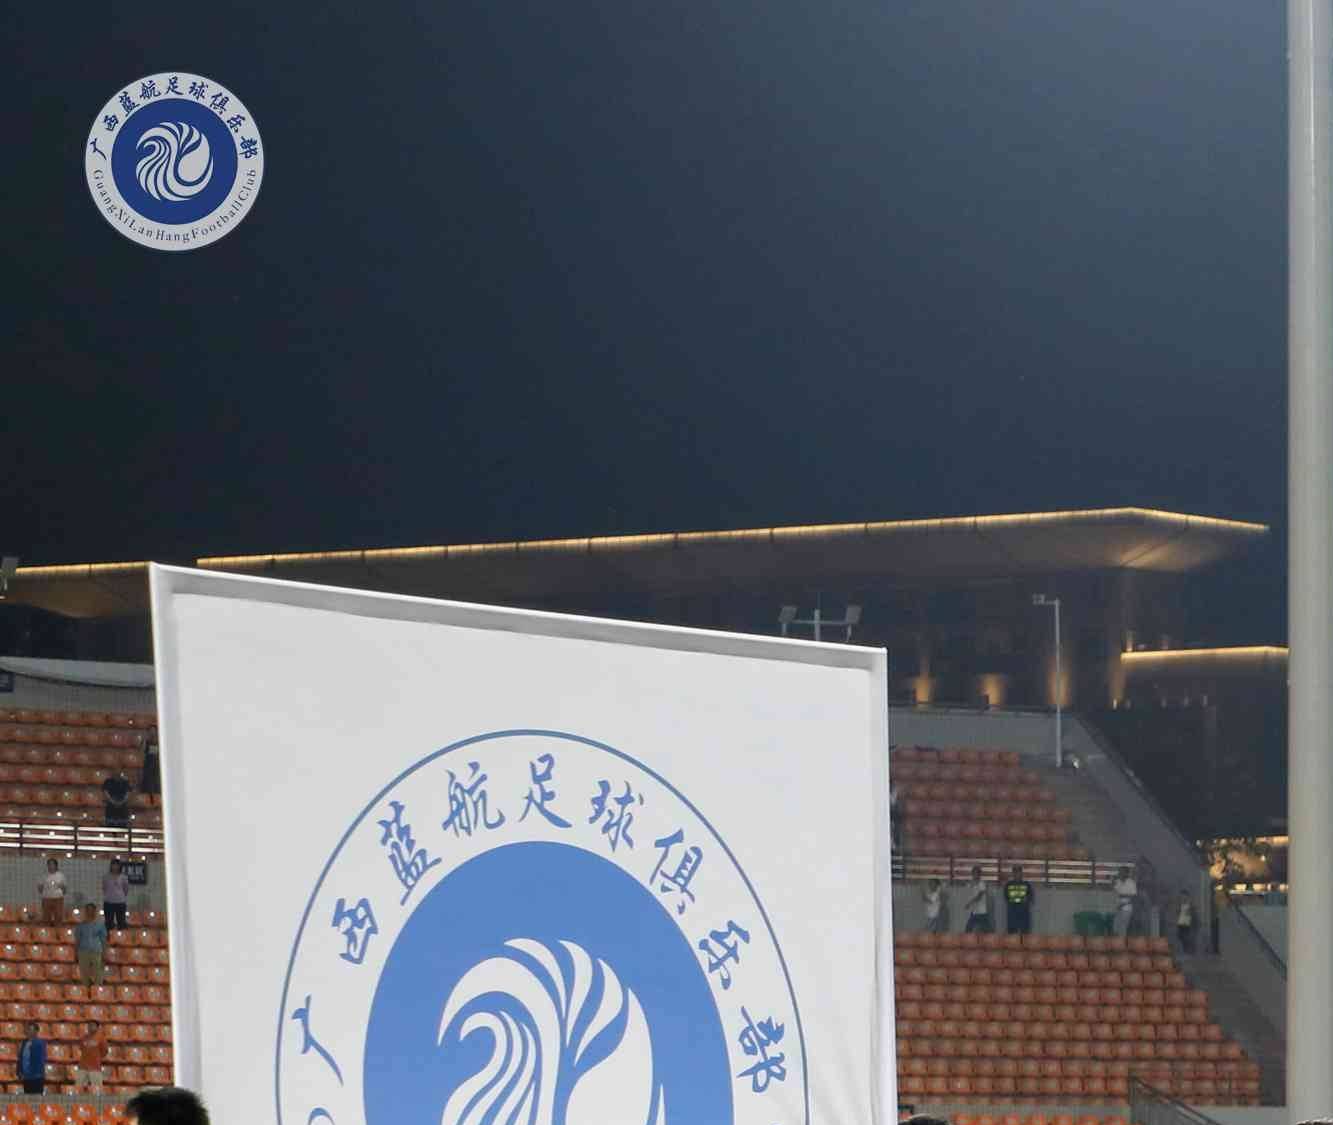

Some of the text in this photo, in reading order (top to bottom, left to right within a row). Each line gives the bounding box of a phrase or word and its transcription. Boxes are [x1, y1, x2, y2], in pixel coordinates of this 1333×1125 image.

[291, 753, 787, 1093] 广西蓝航足球俱乐部
